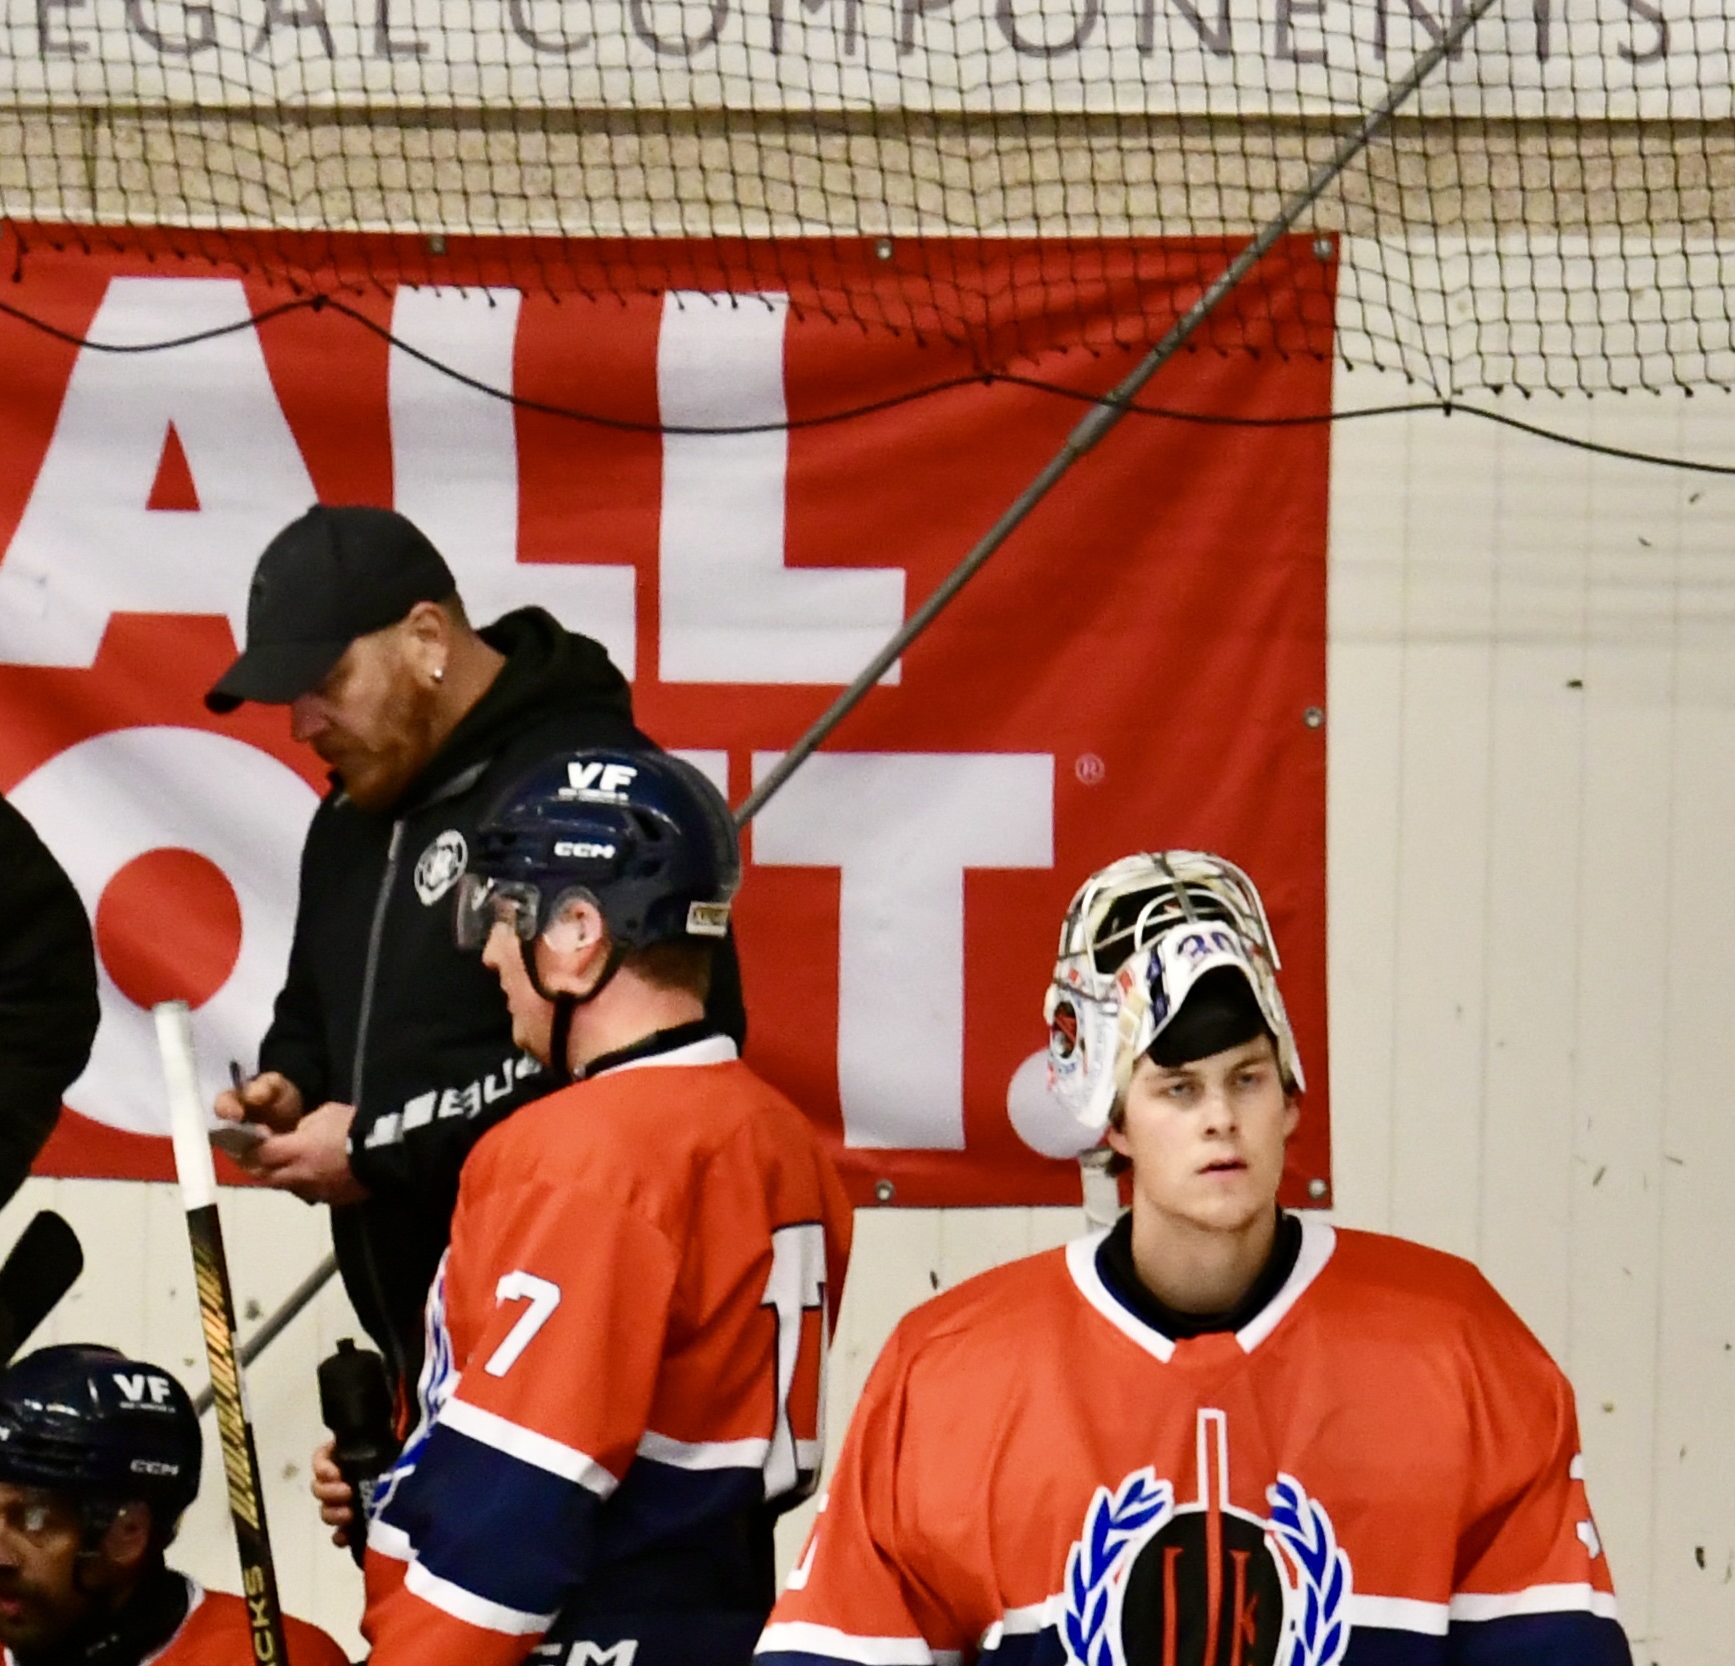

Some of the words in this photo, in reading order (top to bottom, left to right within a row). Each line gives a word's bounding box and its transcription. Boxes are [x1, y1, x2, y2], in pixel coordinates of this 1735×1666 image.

[565, 760, 638, 794] VF
[554, 838, 616, 862] CCM
[111, 1372, 172, 1403] VF
